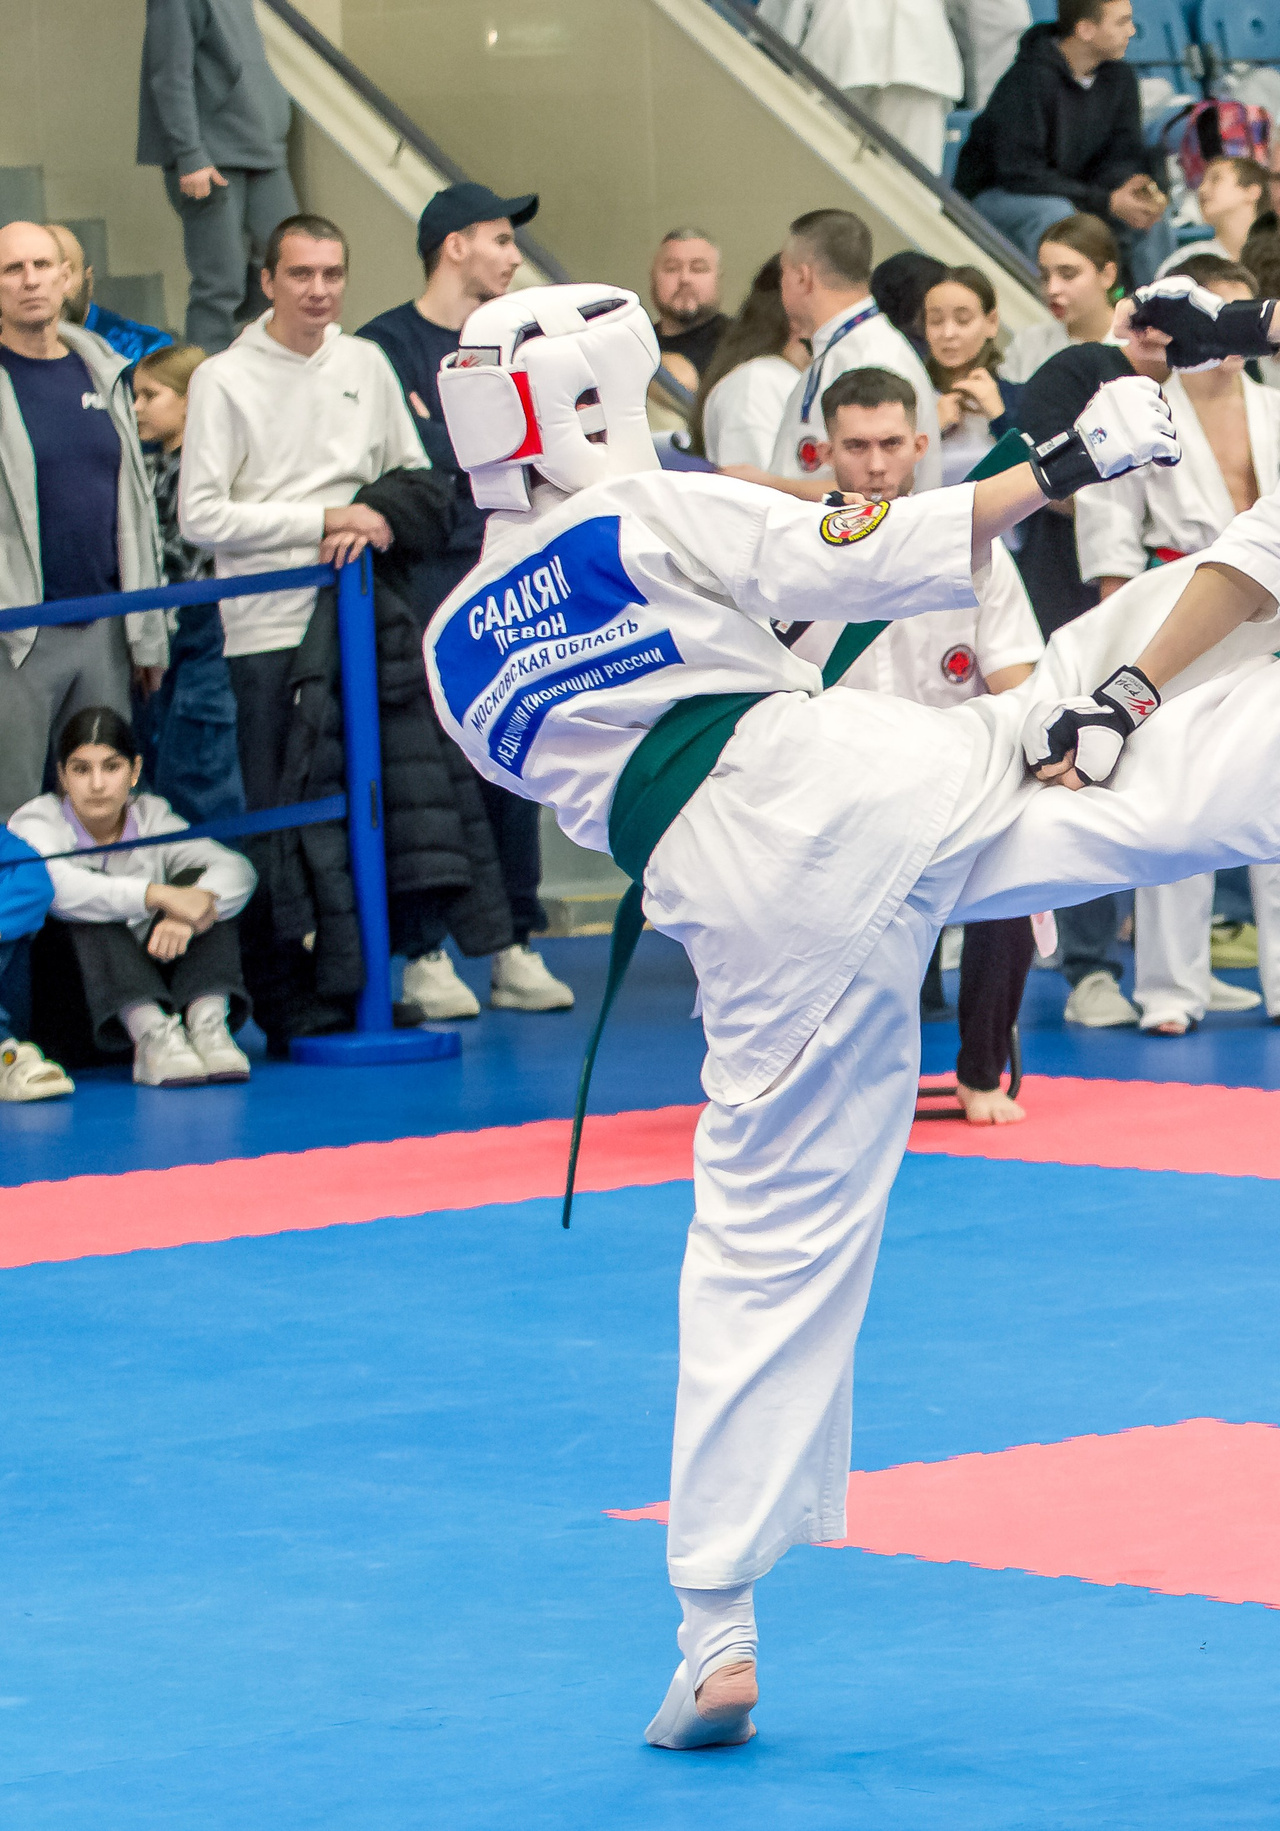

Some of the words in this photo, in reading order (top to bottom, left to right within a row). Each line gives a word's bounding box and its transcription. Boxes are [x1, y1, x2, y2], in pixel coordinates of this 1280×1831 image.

[470, 647, 552, 736] МОСКОВСКАЯ
[555, 619, 639, 660] ОБЛАСТЬ
[521, 668, 606, 714] КИОКУШИН
[602, 647, 666, 679] РОССИИ
